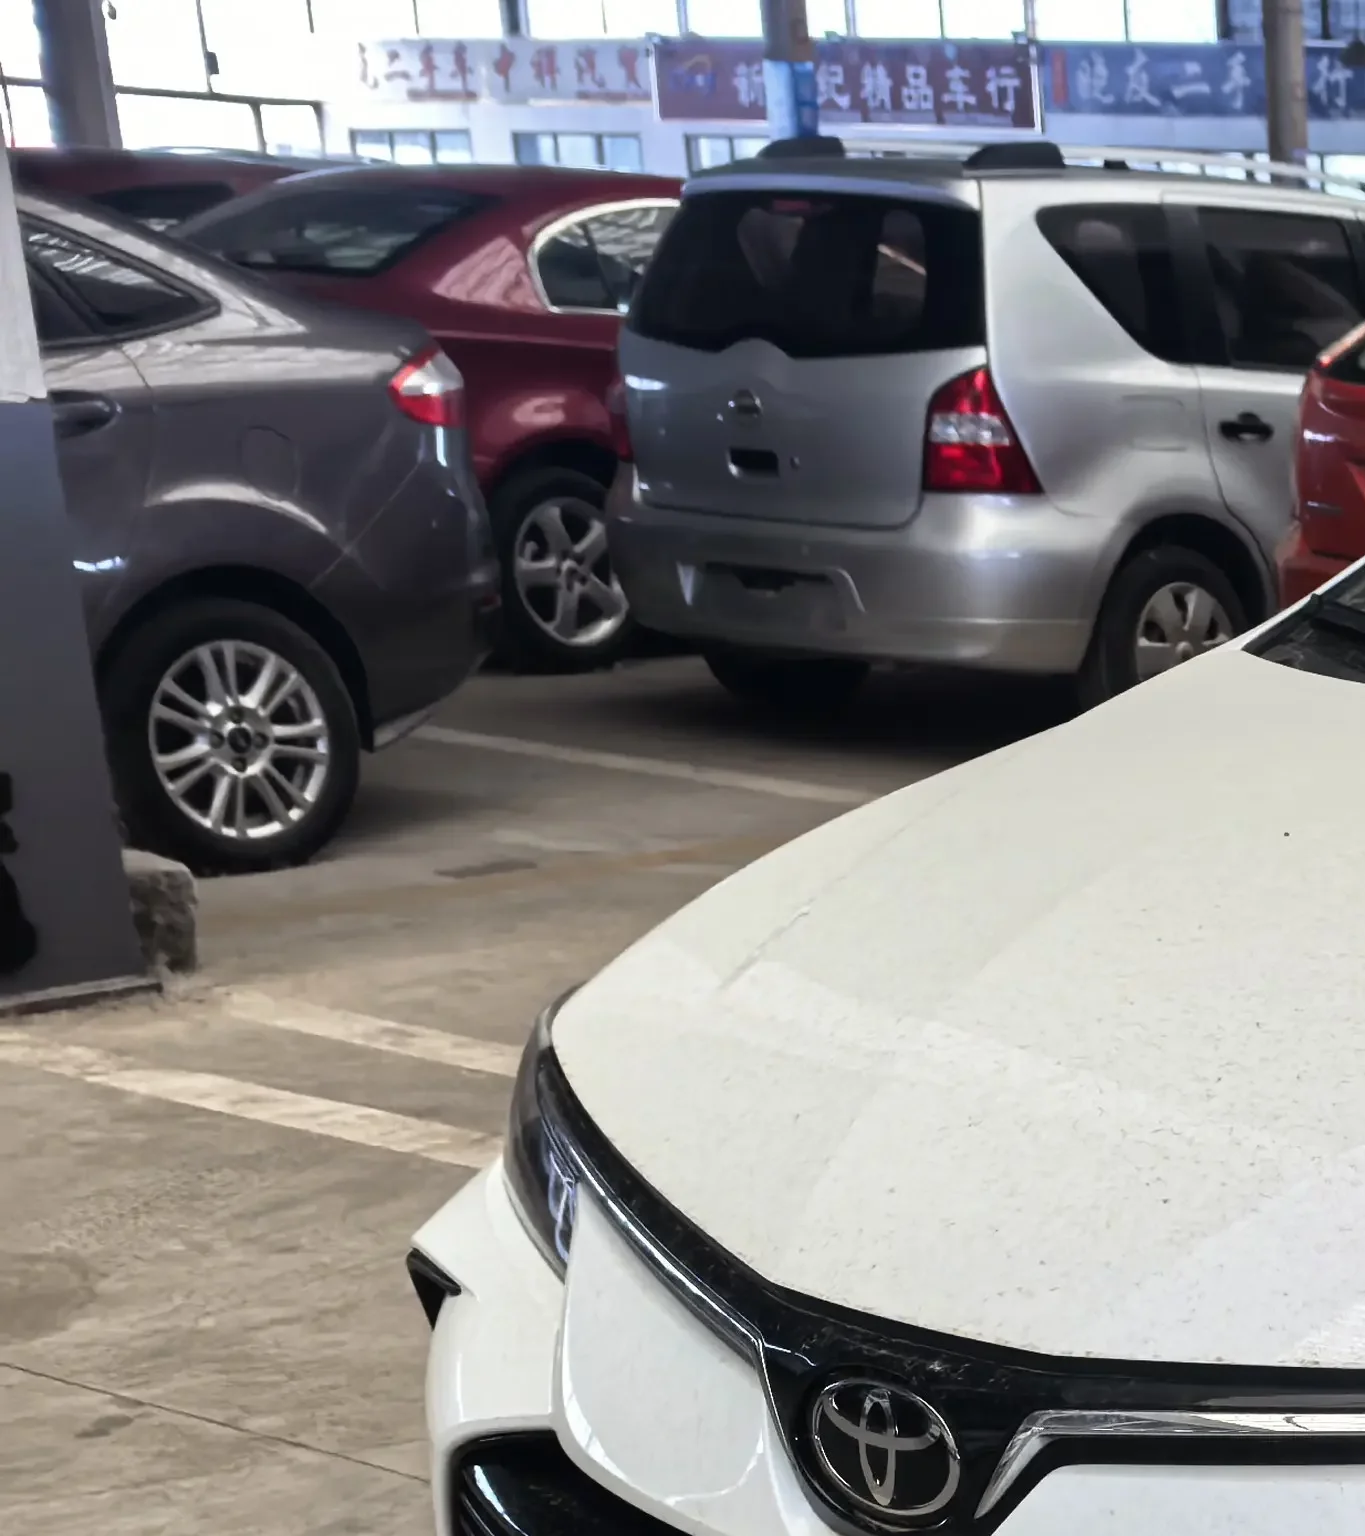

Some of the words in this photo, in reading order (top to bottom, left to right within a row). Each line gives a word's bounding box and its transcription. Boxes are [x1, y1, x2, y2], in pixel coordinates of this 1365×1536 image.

[733, 61, 1021, 112] 新纪精品车行
